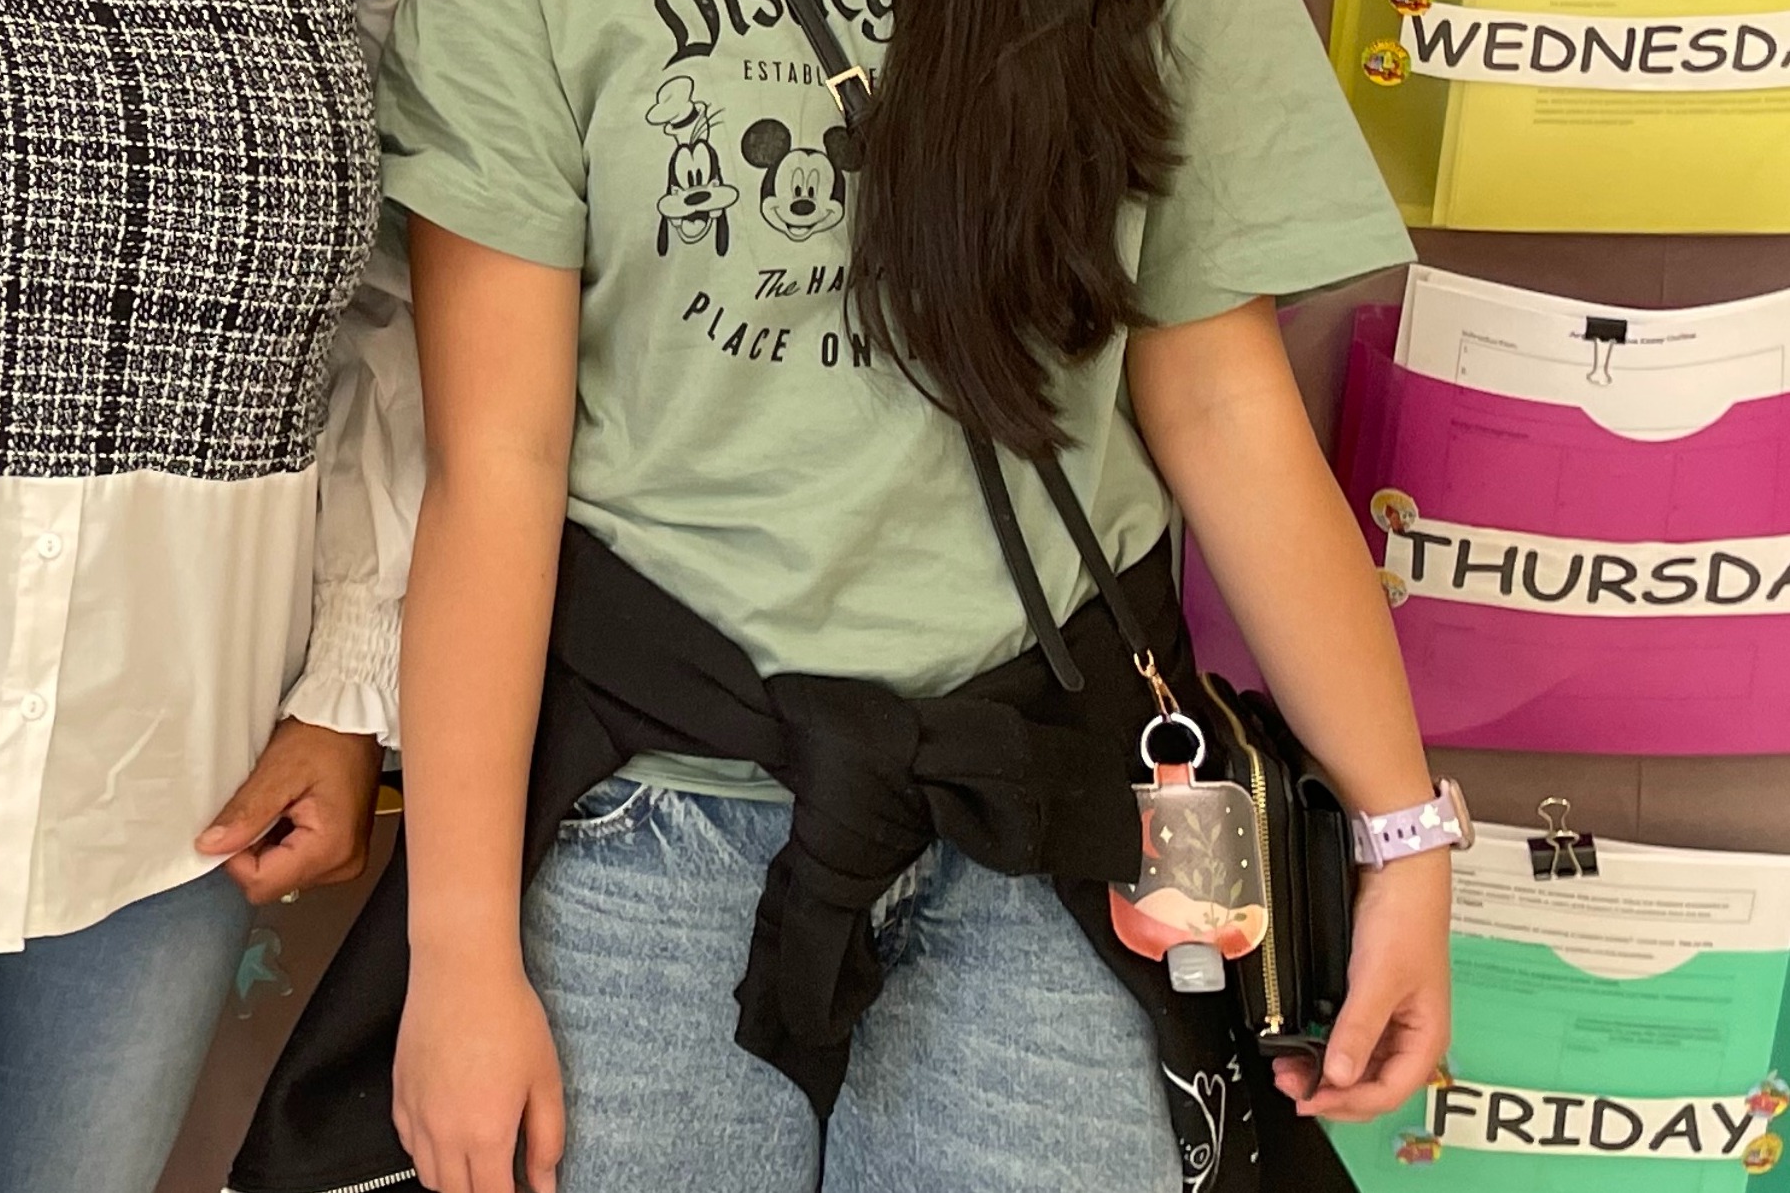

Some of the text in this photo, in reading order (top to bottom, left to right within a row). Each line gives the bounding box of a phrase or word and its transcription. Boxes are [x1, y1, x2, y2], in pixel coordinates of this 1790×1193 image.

[1410, 14, 1790, 74] WEDNESD
[754, 268, 801, 300] The
[682, 290, 872, 367] PLACE ON
[1432, 1086, 1756, 1154] FRIDAY
